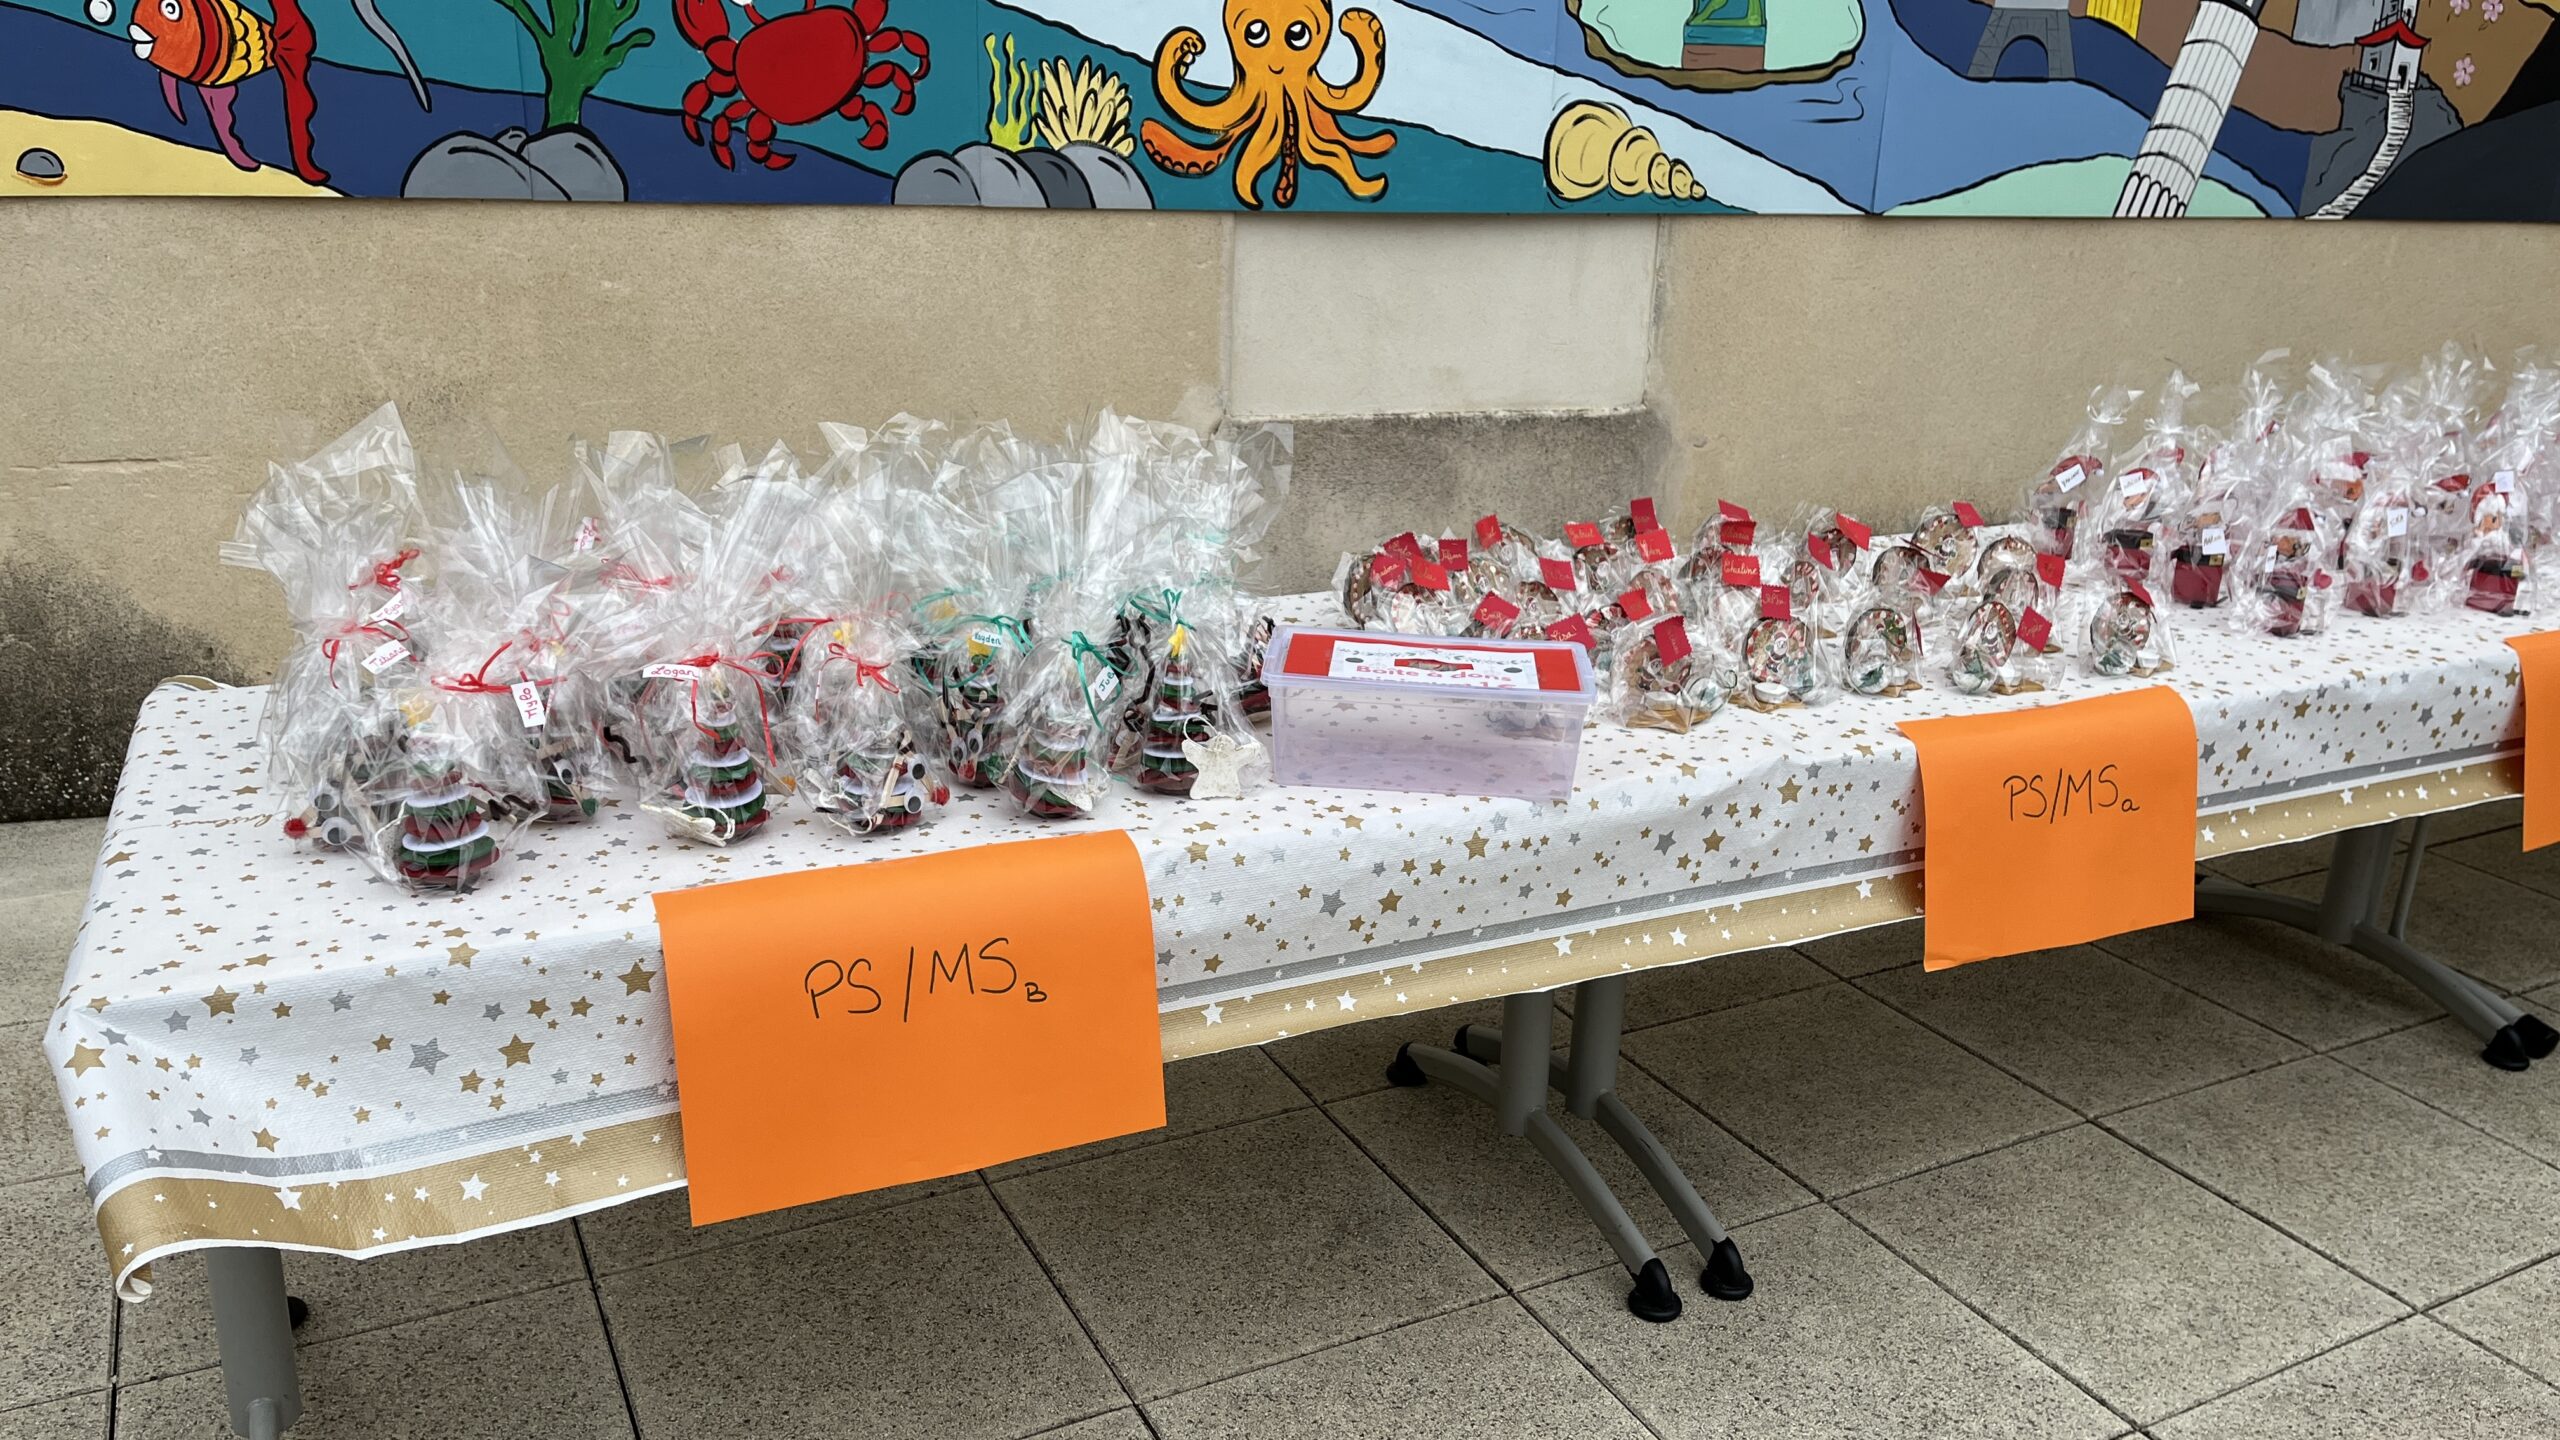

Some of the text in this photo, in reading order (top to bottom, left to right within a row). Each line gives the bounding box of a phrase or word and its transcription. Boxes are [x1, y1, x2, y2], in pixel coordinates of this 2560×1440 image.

[651, 665, 700, 678] Logan
[1451, 671, 1511, 681] dons
[519, 687, 538, 720] Mylo
